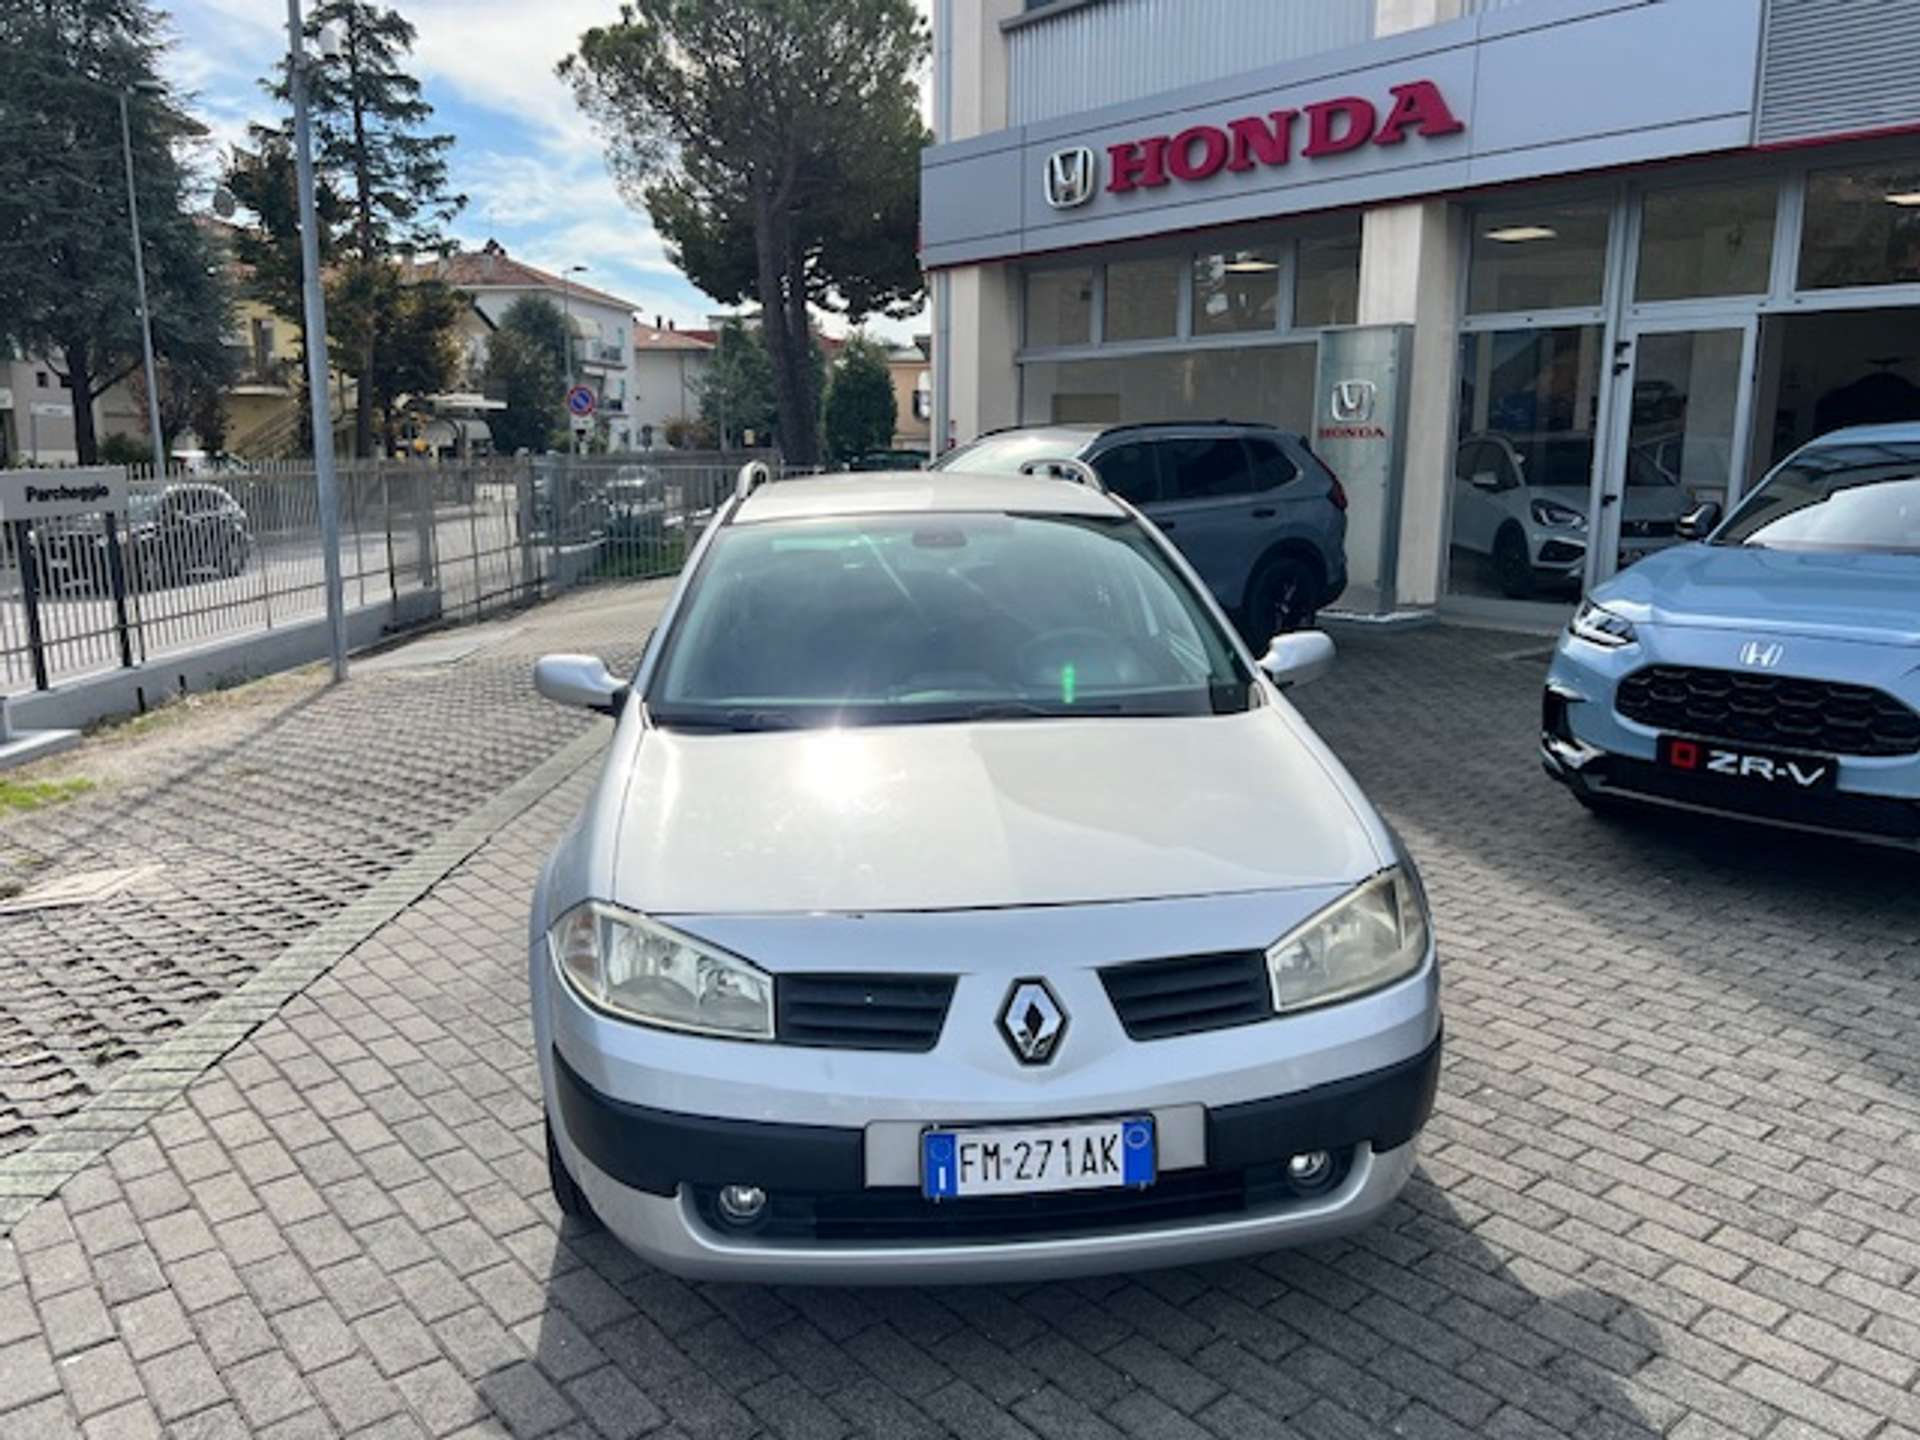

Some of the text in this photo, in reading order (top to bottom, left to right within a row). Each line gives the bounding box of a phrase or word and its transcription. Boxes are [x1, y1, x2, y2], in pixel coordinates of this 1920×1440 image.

[1106, 80, 1464, 193] HONDA
[1319, 426, 1384, 439] HONDA
[25, 484, 109, 502] Parcheggio
[1707, 750, 1826, 786] ZR-V
